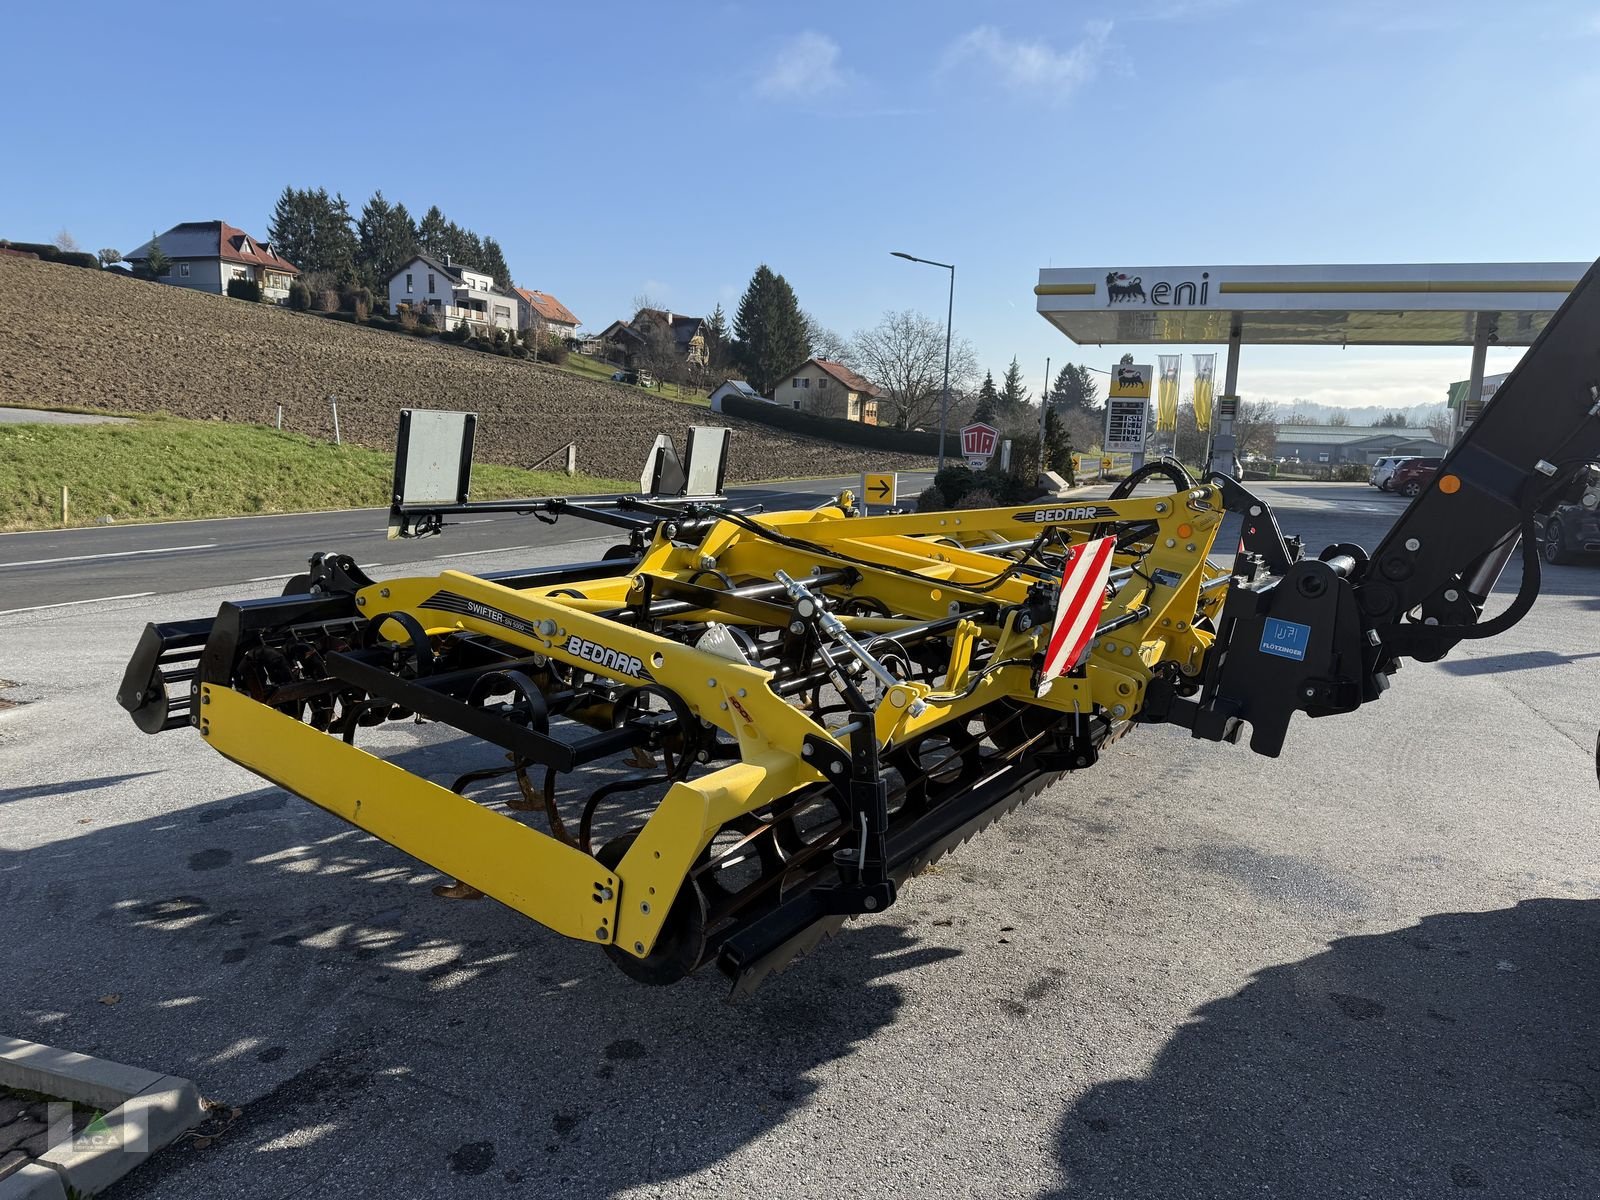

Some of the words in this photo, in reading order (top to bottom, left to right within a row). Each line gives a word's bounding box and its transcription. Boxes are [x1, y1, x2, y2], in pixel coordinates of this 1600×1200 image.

[1151, 272, 1209, 305] eni
[1035, 507, 1097, 522] BEDNAR
[467, 601, 503, 622] SWIFTER
[567, 636, 643, 678] BEDNAR
